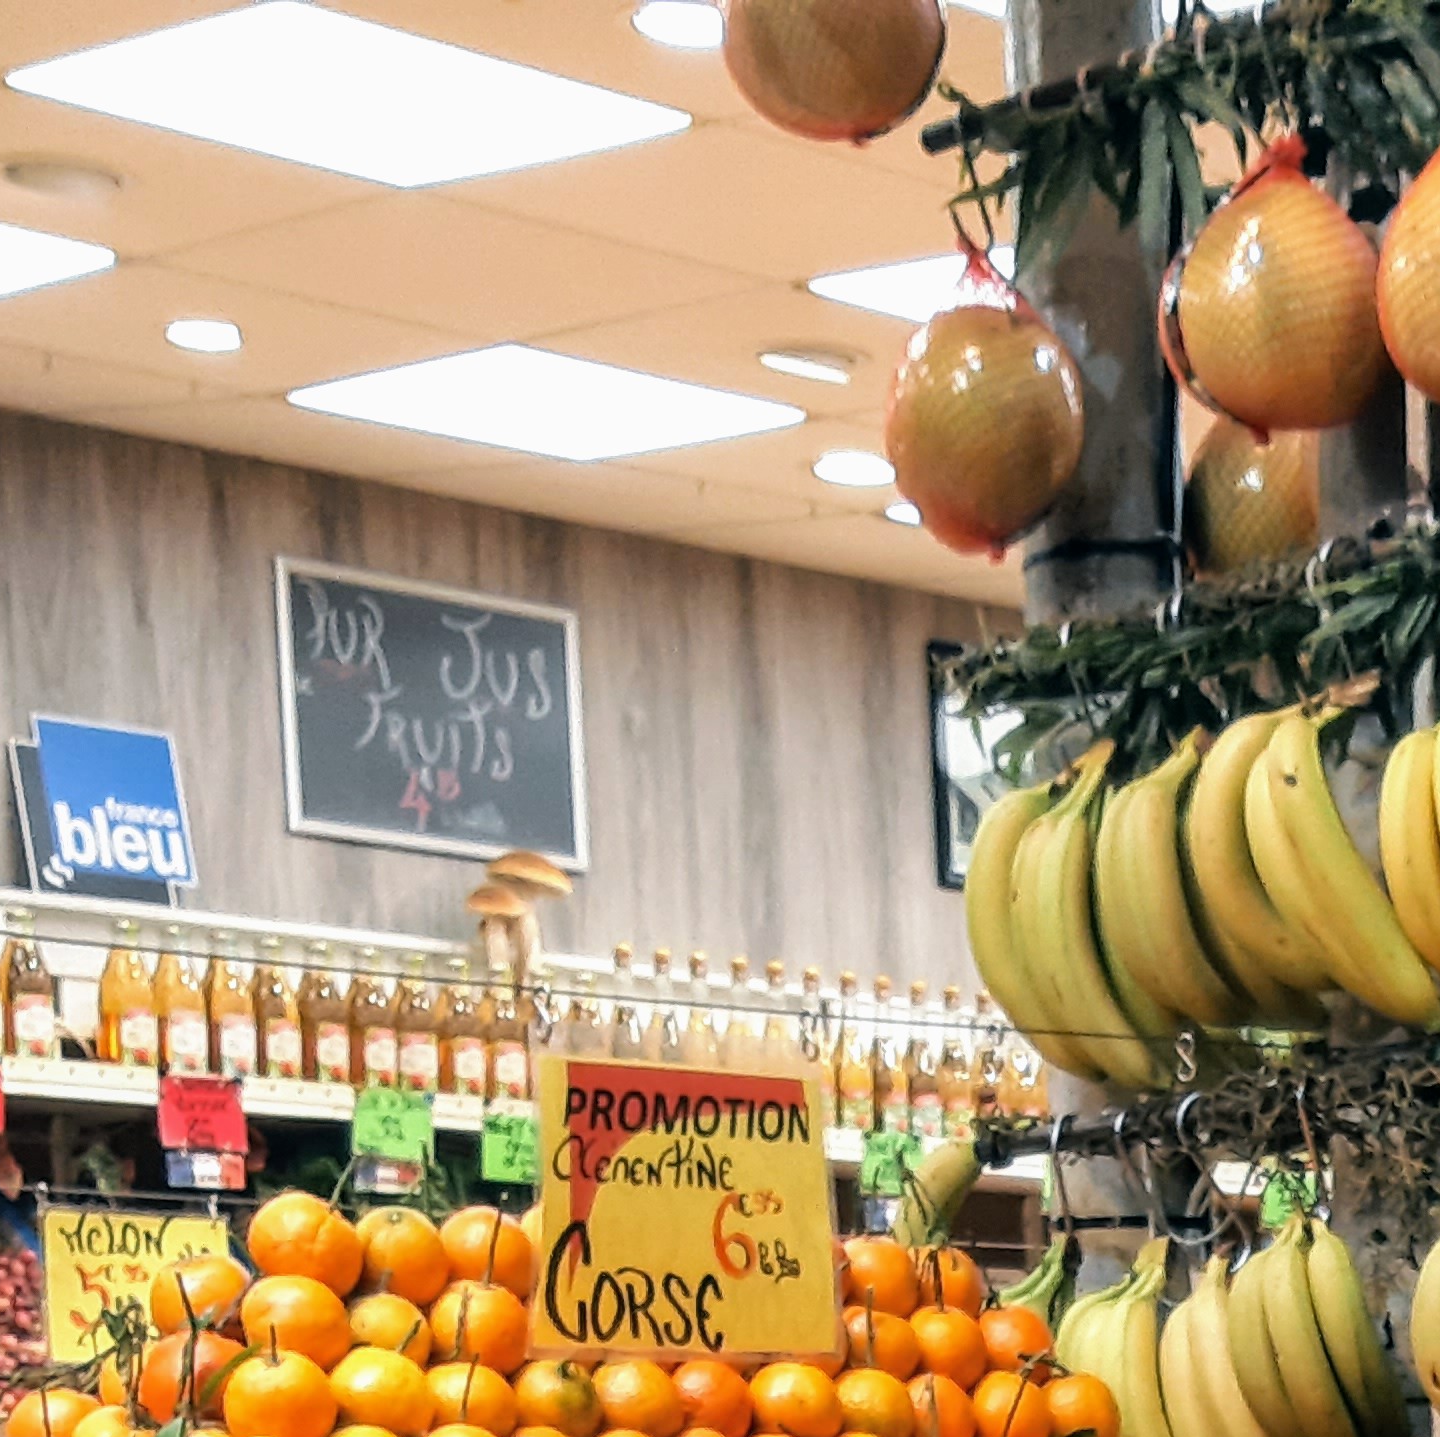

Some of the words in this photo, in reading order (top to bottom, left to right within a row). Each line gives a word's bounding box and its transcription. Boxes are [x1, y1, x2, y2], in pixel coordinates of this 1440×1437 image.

[440, 613, 551, 720] JUS
[52, 801, 187, 877] bleu
[105, 796, 177, 828] france
[563, 1088, 810, 1143] PROMOTION
[545, 1220, 724, 1352] CORSE
